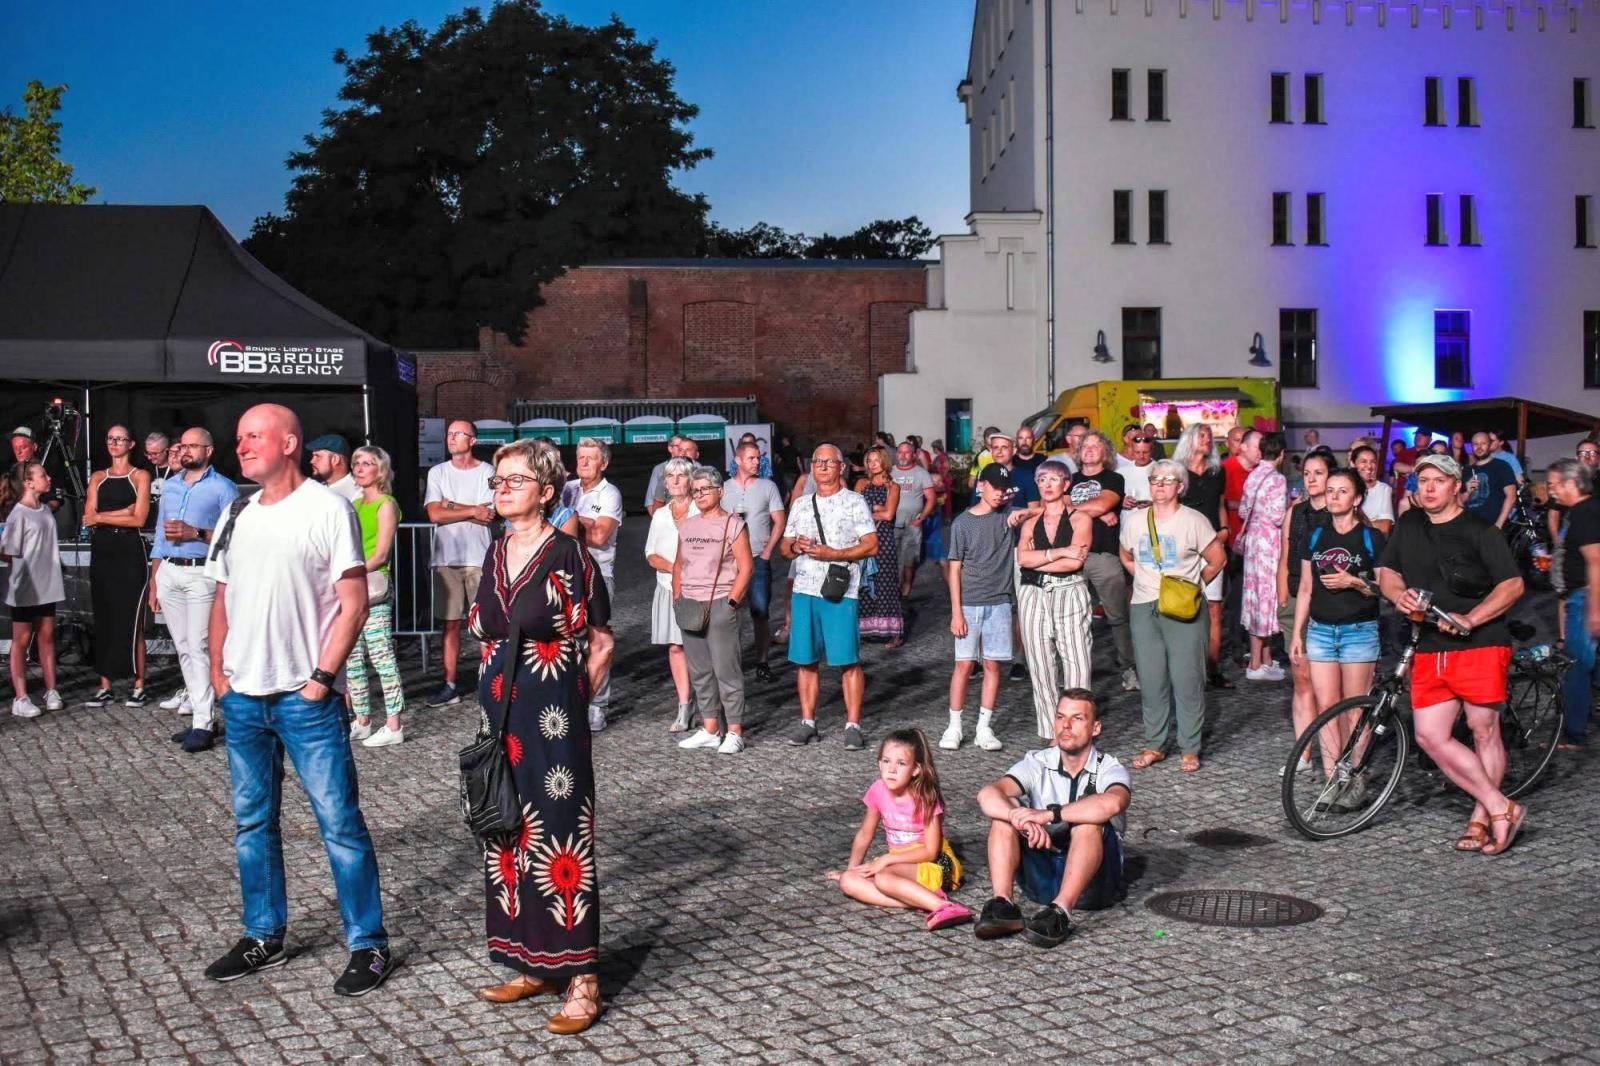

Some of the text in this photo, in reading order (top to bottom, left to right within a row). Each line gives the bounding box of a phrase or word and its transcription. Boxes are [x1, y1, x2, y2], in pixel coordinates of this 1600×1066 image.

[220, 351, 343, 373] BB GROUP
[269, 365, 343, 375] AGENCY
[1334, 553, 1362, 567] Rock
